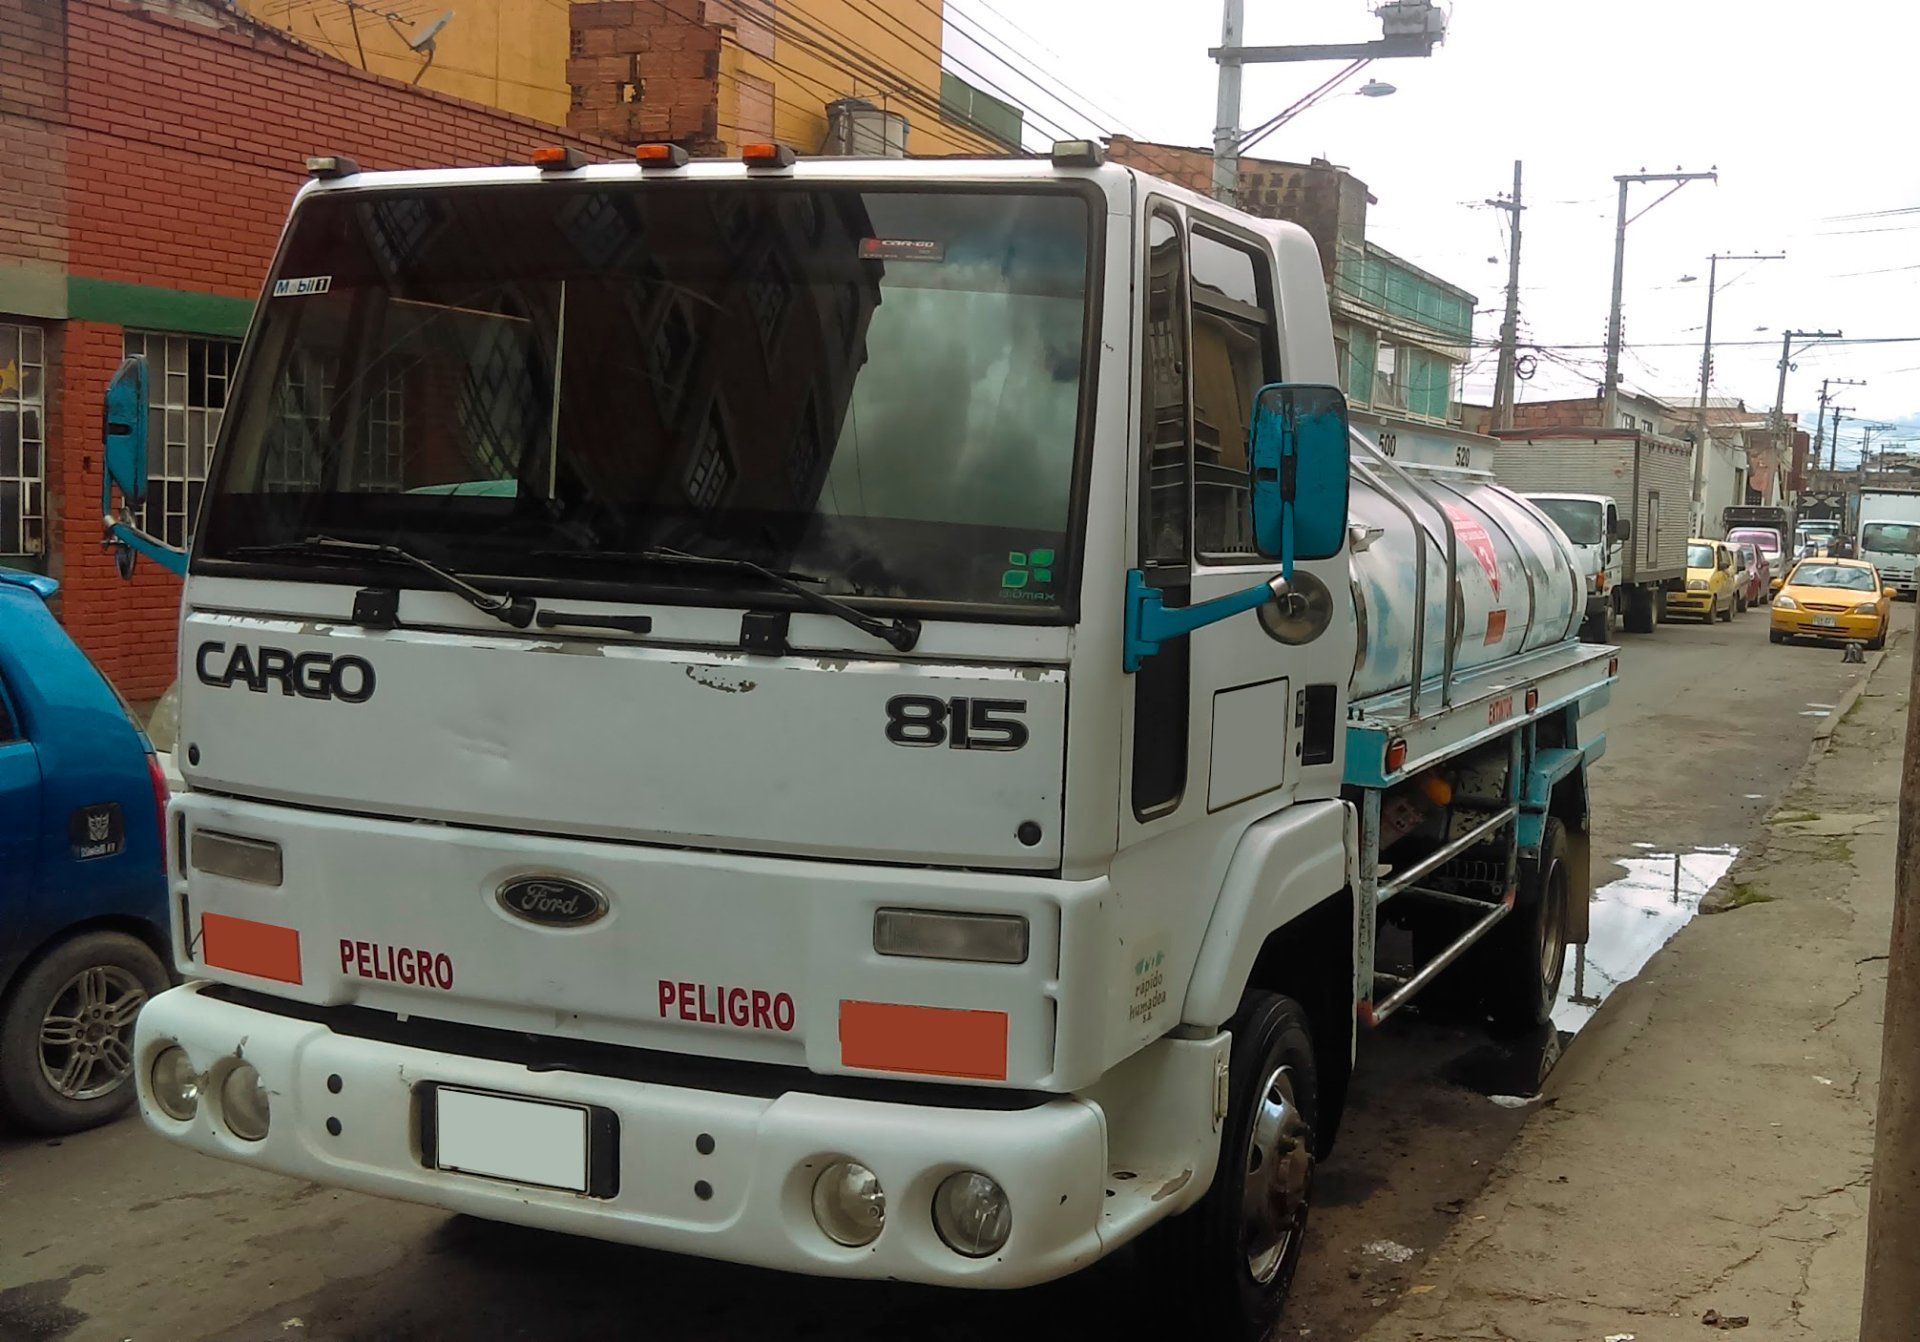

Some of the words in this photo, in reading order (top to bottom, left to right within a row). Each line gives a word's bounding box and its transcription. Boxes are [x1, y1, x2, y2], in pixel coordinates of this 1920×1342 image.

[1456, 446, 1470, 467] 520
[196, 641, 376, 704] CARGO
[885, 694, 1029, 752] 815
[522, 884, 579, 914] Ford
[340, 938, 453, 990] PELIGRO
[658, 980, 796, 1032] PELIGRO
